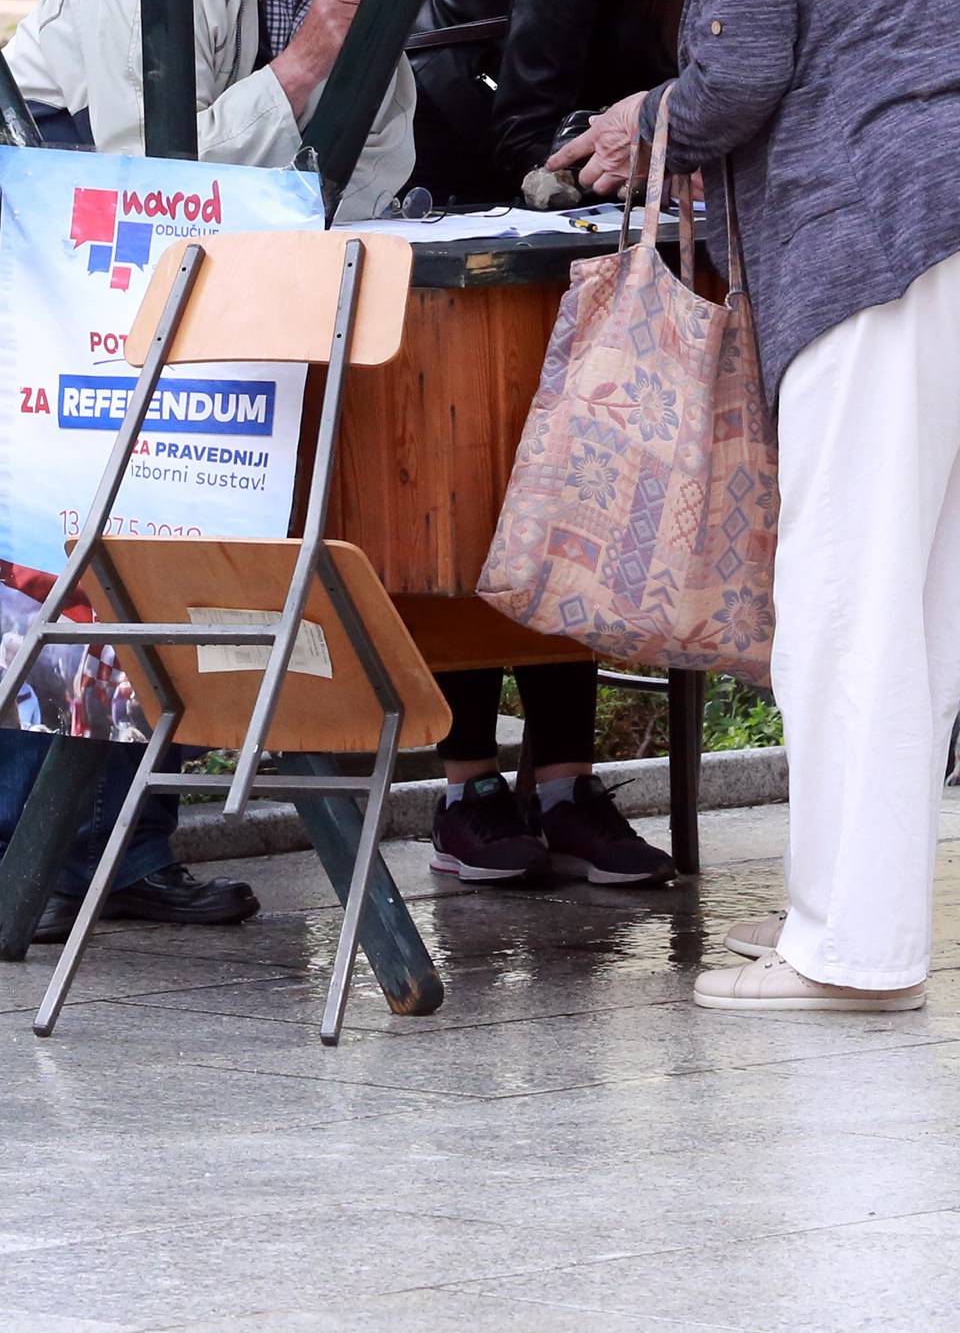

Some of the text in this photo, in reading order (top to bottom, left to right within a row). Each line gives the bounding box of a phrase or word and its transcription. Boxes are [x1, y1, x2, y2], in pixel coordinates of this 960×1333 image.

[122, 180, 222, 224] narod
[90, 331, 129, 355] POT
[20, 387, 267, 423] ZA REFEENDUM
[131, 440, 269, 468] ZA PRAVEDNIJI
[130, 459, 266, 491] izborni sustav!
